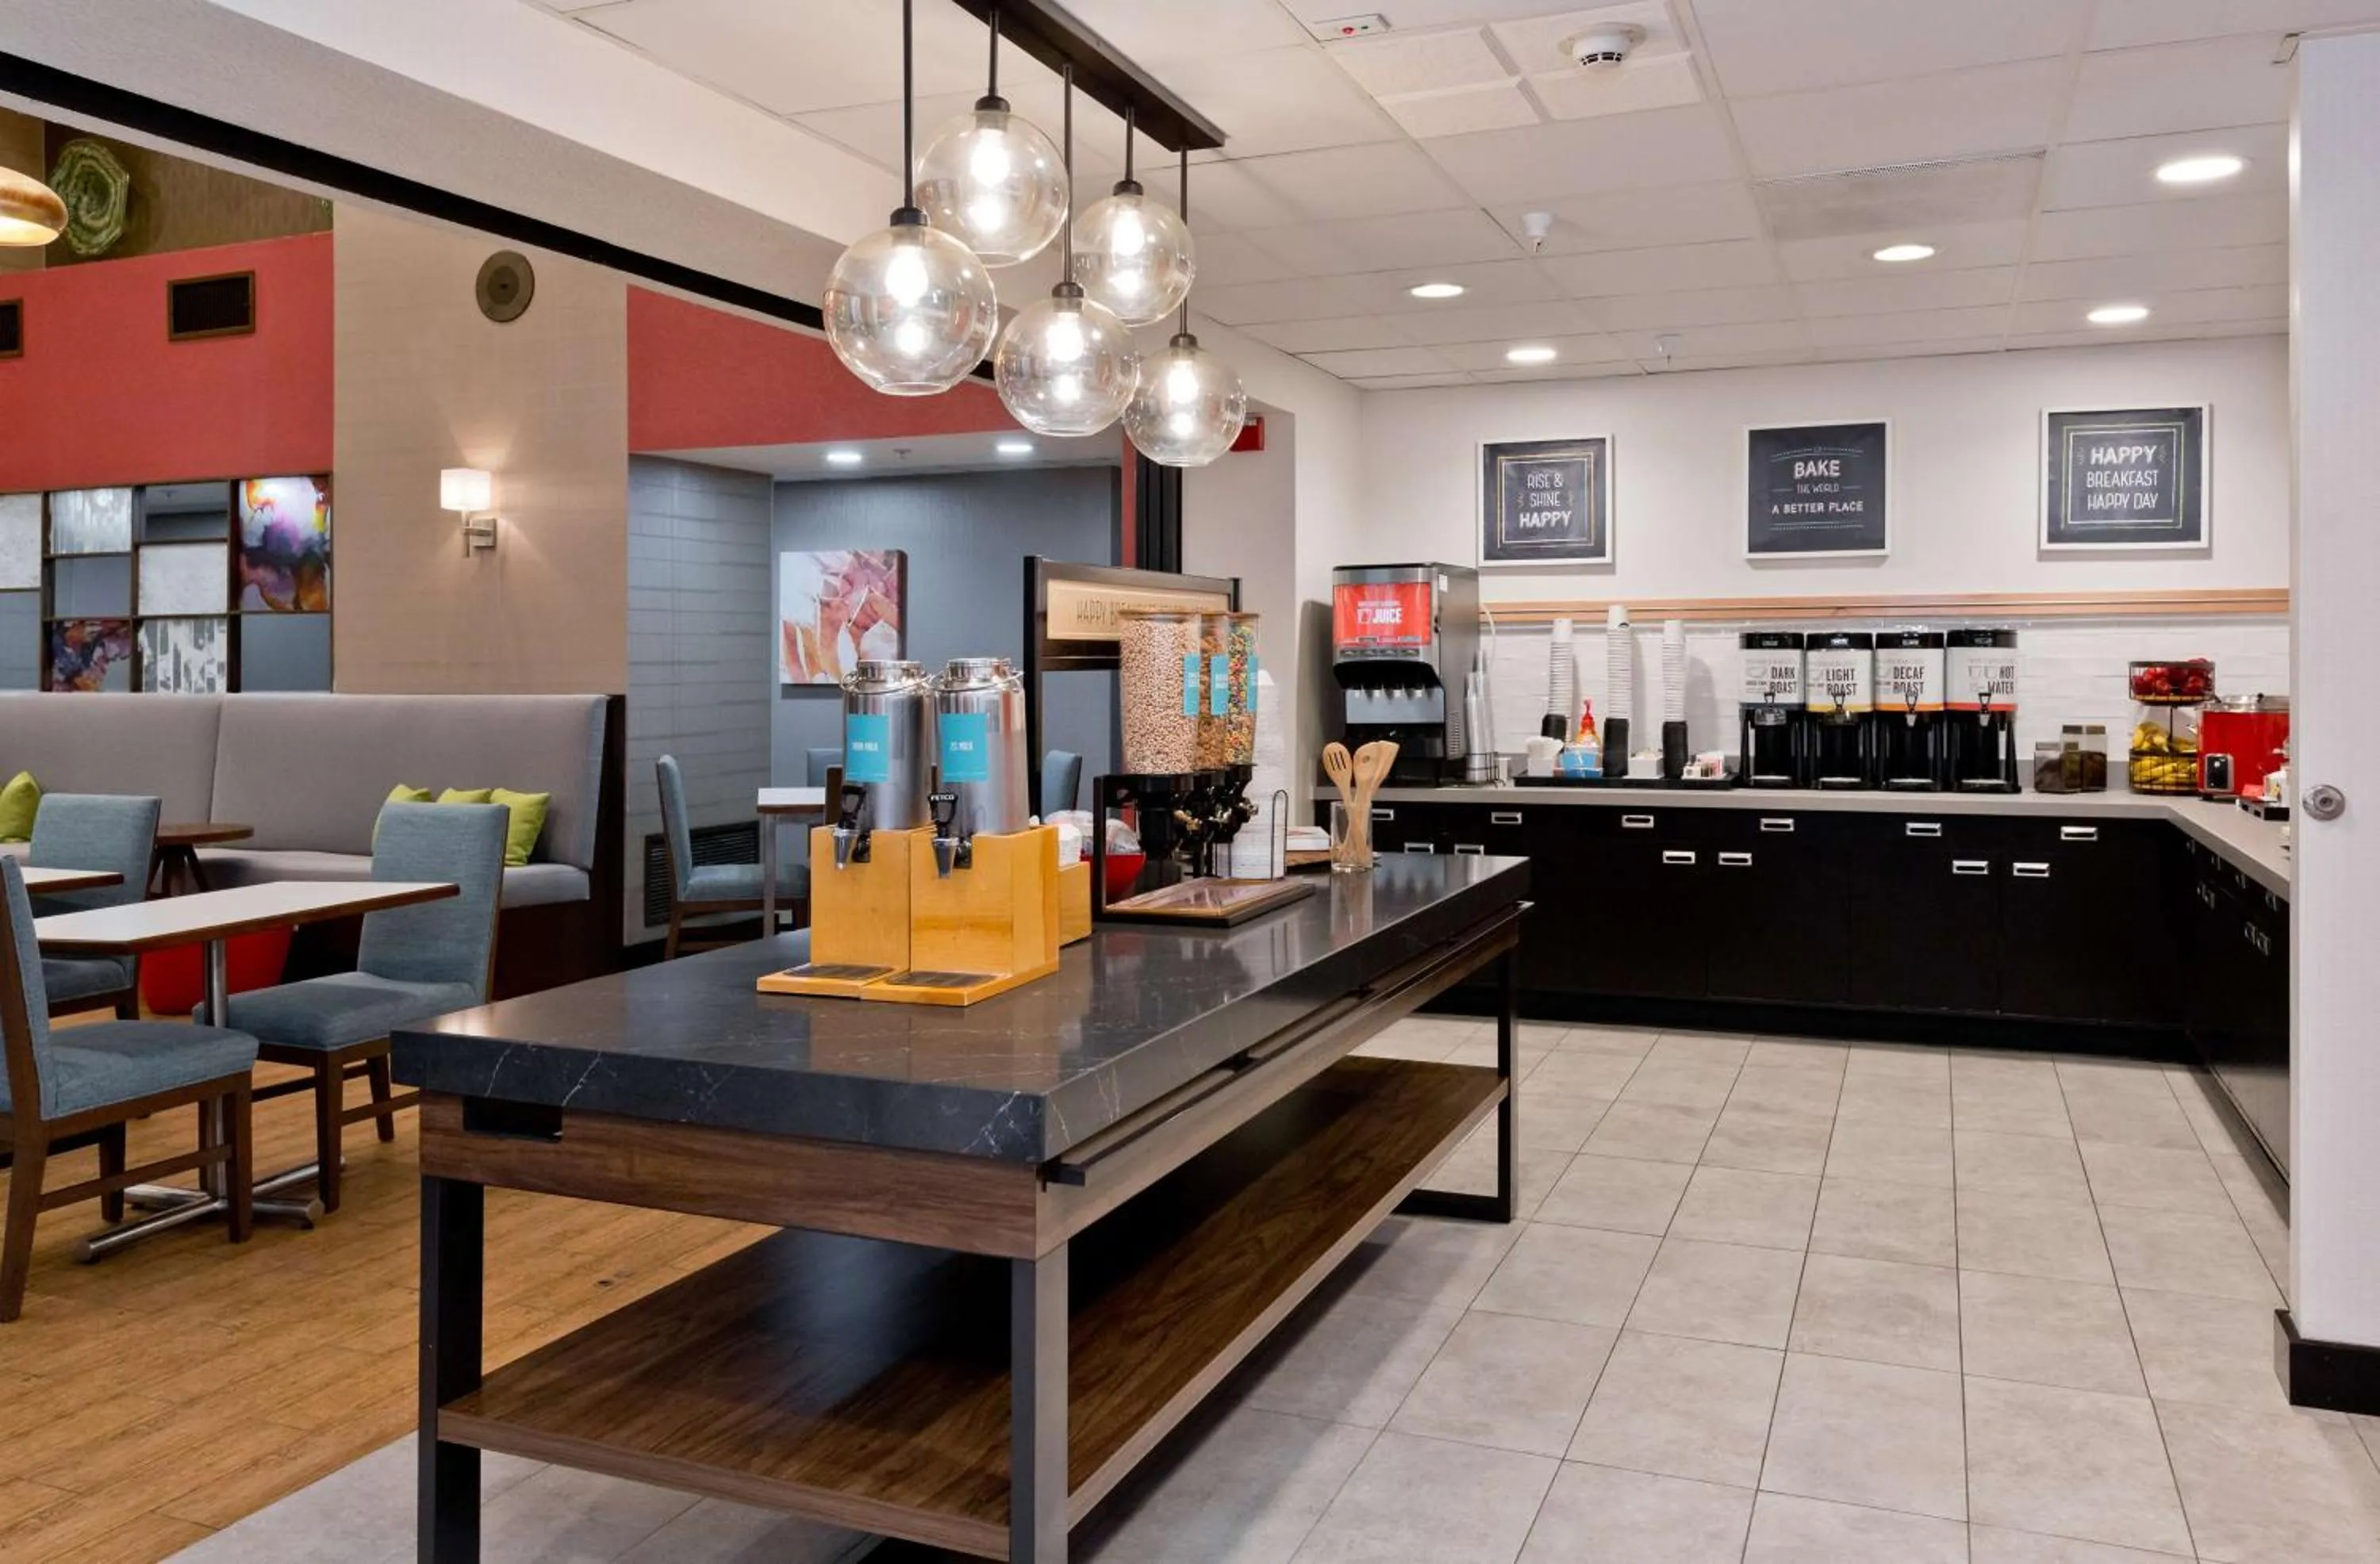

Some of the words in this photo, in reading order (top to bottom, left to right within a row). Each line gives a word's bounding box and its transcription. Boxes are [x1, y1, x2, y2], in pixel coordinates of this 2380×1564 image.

[2090, 445, 2157, 465] HAPPY
[1794, 459, 1841, 480] BAKE
[1527, 473, 1551, 489] RISE
[1554, 472, 1563, 488] &
[2086, 470, 2159, 488] BREAKFAST
[1811, 482, 1840, 493] WORLD
[1530, 492, 1561, 508] SHINE
[1772, 504, 1779, 515] A
[1783, 502, 1825, 515] BETTER
[1828, 500, 1864, 513] PLACE
[2087, 493, 2130, 511] HAPPY
[2133, 493, 2159, 509] DAY
[1519, 510, 1572, 528] HAPPY
[1077, 600, 1107, 625] HAPPY
[1372, 608, 1403, 624] JUICE
[1771, 666, 1795, 680] DARK
[1826, 668, 1856, 682] LIGHT
[1893, 666, 1925, 680] DECAF
[1999, 665, 2015, 680] HOT
[1769, 681, 1797, 695] ROAST
[1827, 683, 1858, 696] ROAST
[1893, 681, 1925, 696] ROAST
[1987, 681, 2015, 696] WATER
